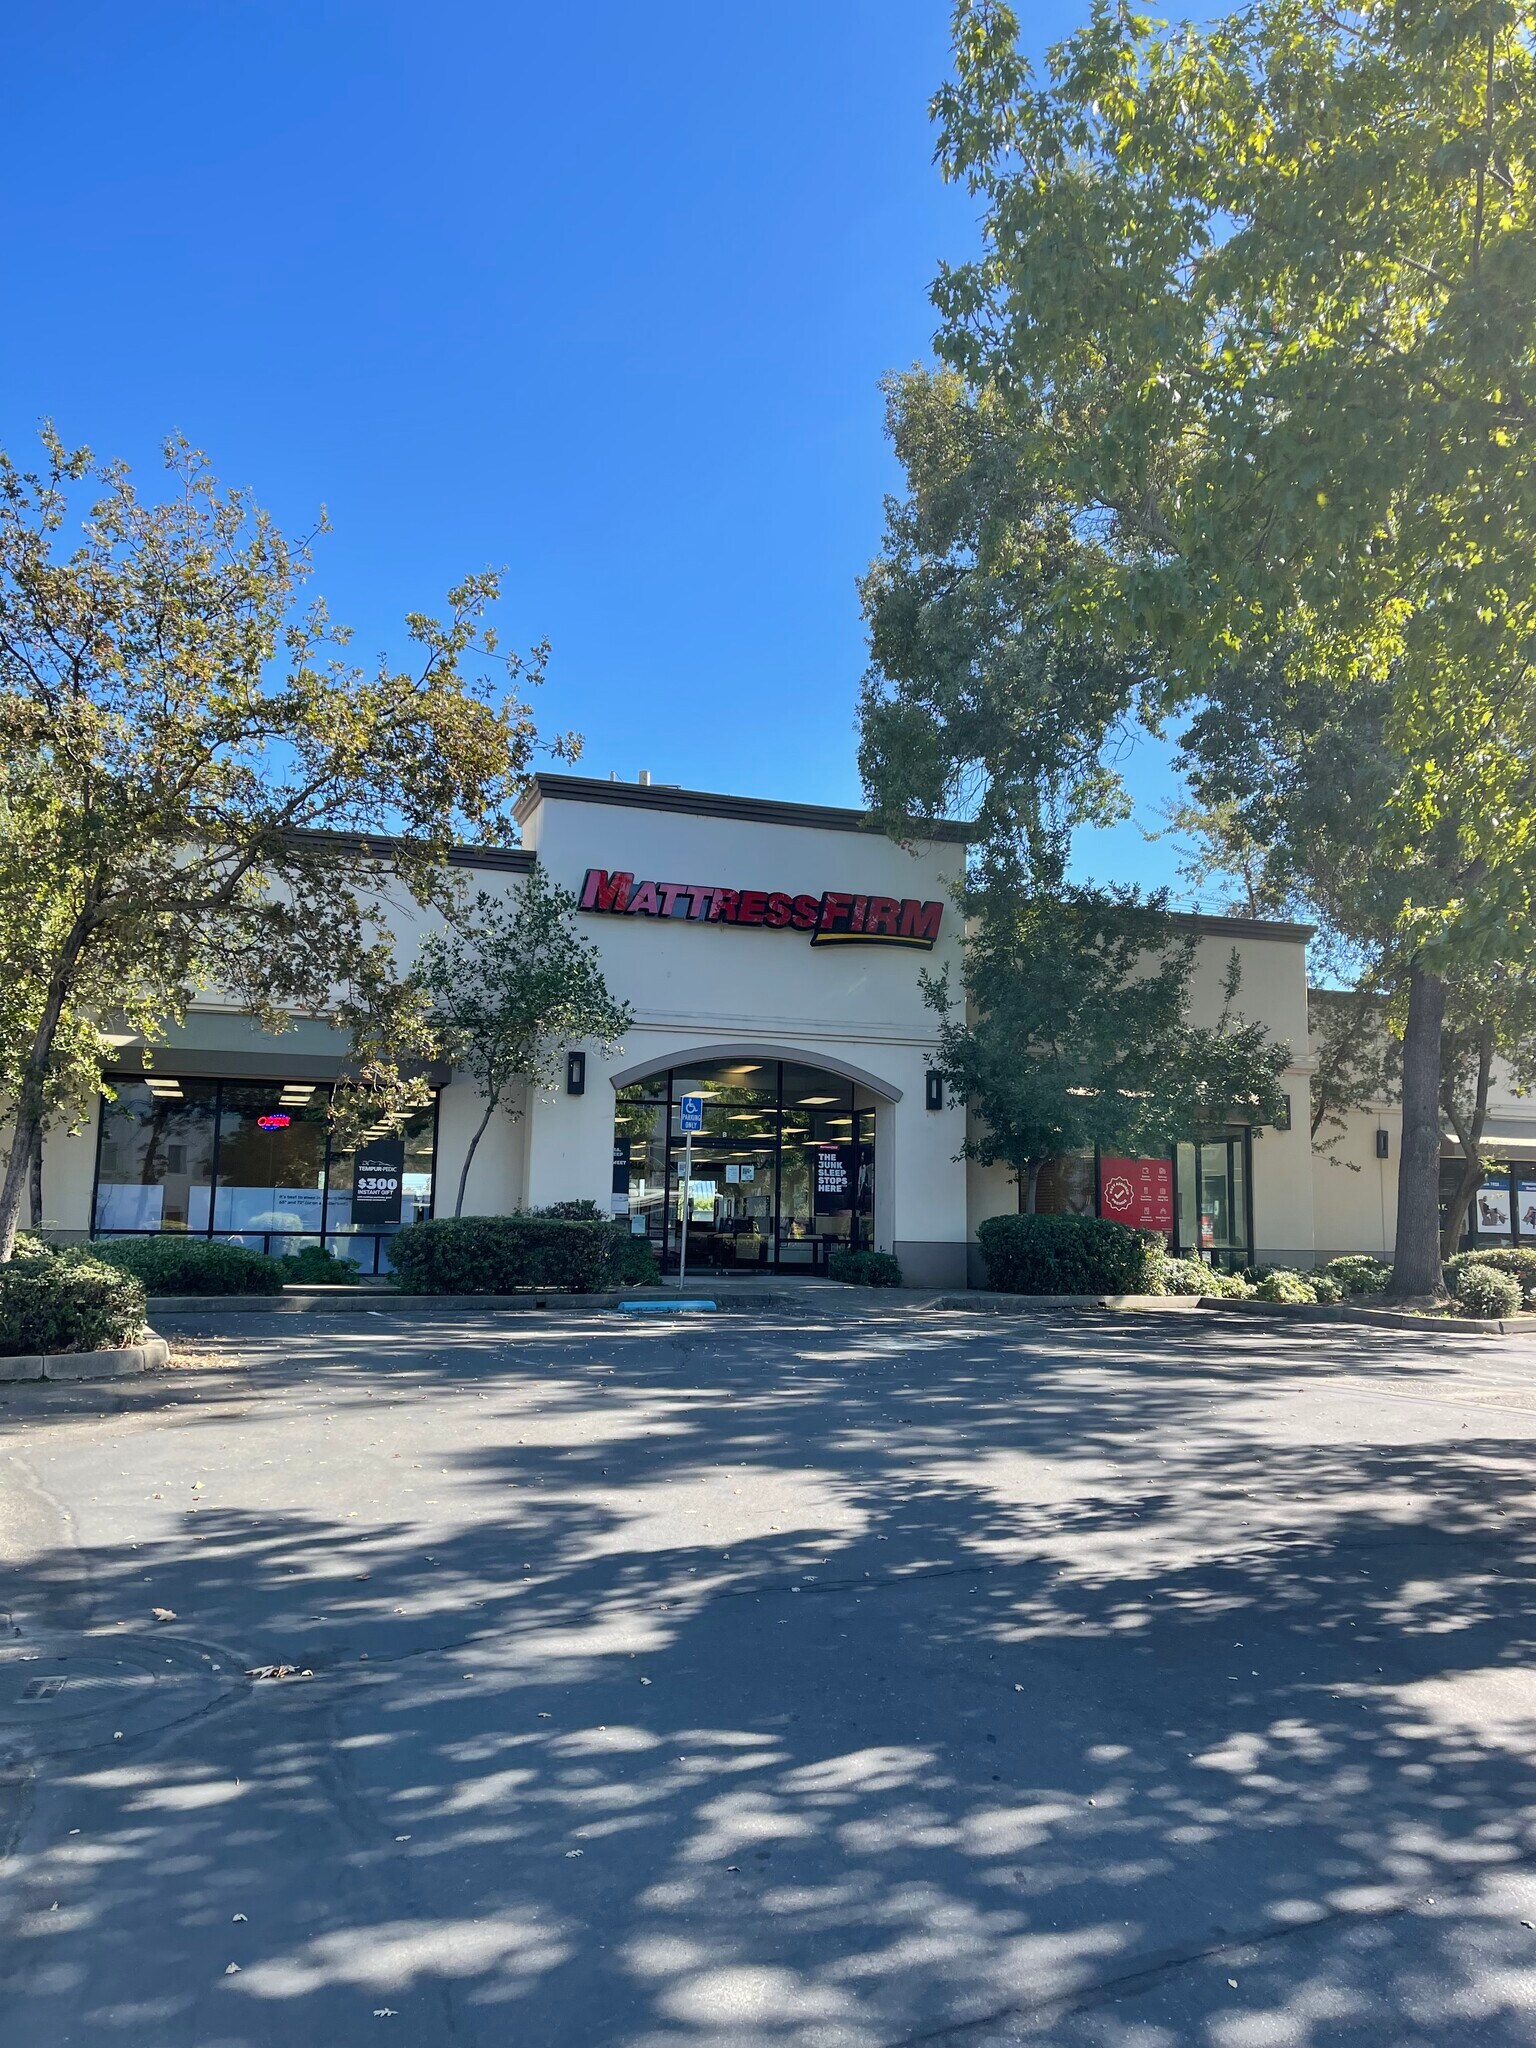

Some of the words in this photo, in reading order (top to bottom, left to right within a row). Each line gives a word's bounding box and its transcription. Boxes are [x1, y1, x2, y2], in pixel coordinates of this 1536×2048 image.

[579, 868, 819, 931] MATTRESS
[816, 891, 944, 942] FIRM
[257, 1116, 290, 1127] OPEN
[818, 1153, 837, 1161] THE
[818, 1161, 843, 1169] JUNK
[818, 1169, 847, 1177] SLEEP
[357, 1178, 398, 1190] $300
[818, 1177, 848, 1185] STOPS
[818, 1184, 843, 1193] HERE
